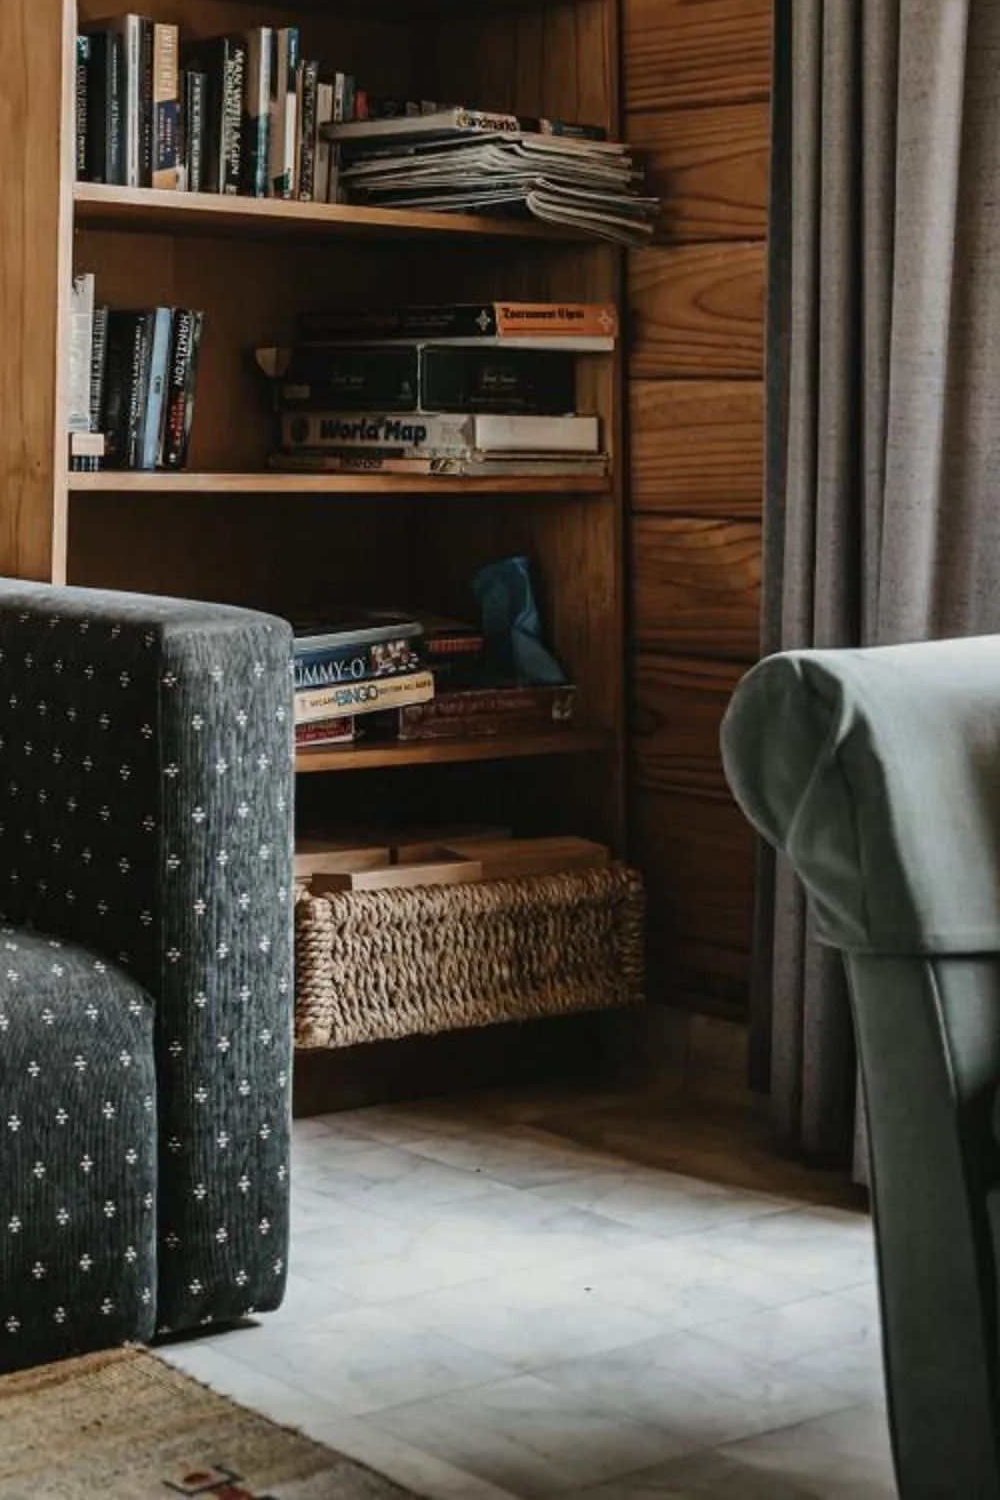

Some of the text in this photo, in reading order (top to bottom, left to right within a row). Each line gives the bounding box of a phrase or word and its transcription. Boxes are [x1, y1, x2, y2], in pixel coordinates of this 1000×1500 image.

[231, 49, 245, 175] MAN WITH A GUN
[173, 314, 191, 385] HAMILTON
[320, 419, 427, 445] World Map
[294, 658, 363, 687] UMMY-O
[335, 684, 378, 707] BINGO
